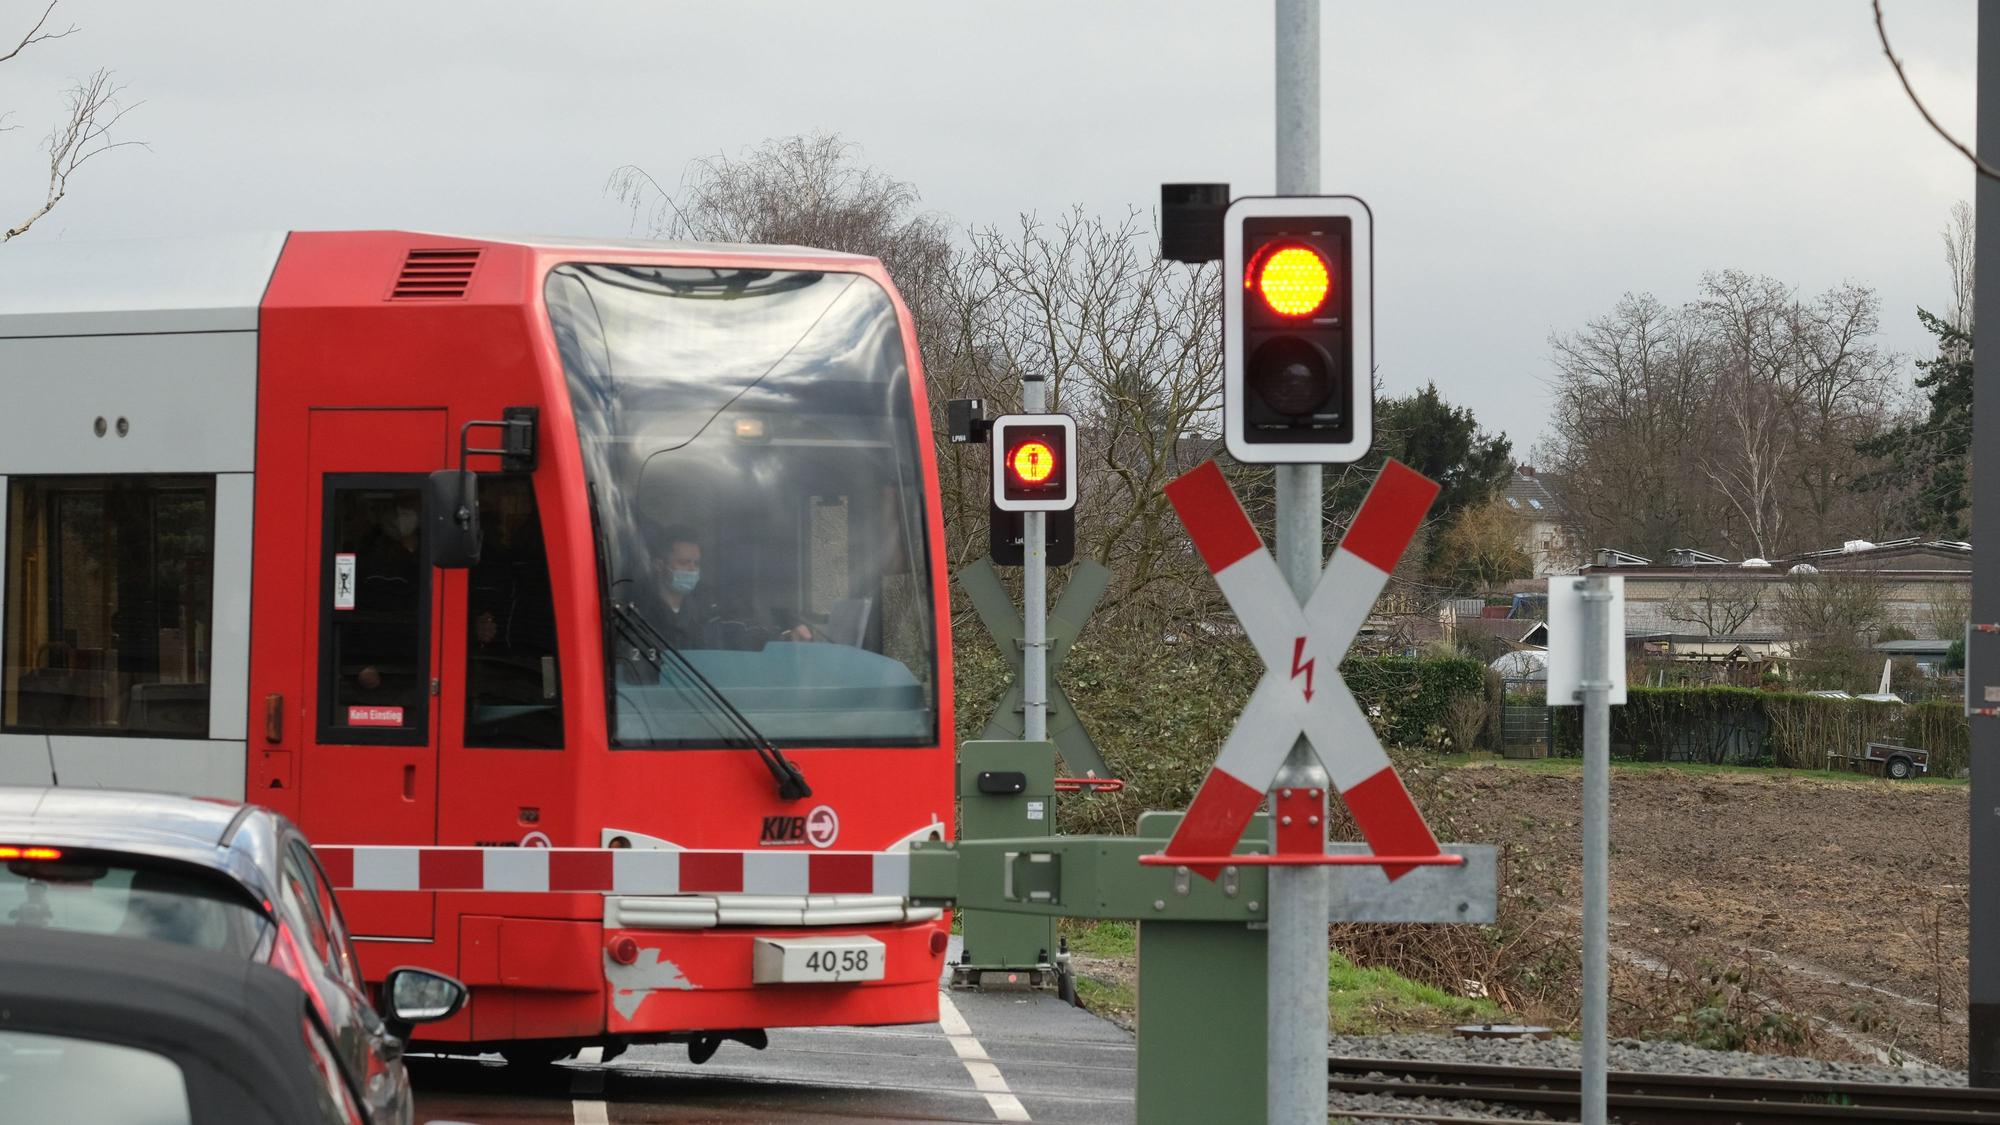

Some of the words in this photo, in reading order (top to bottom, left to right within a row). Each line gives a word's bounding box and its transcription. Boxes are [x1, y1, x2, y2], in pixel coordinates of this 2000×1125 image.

[631, 648, 641, 661] 2
[648, 648, 657, 662] 3
[350, 709, 369, 719] Kein
[370, 709, 402, 723] Einstieg
[761, 815, 806, 841] KVB
